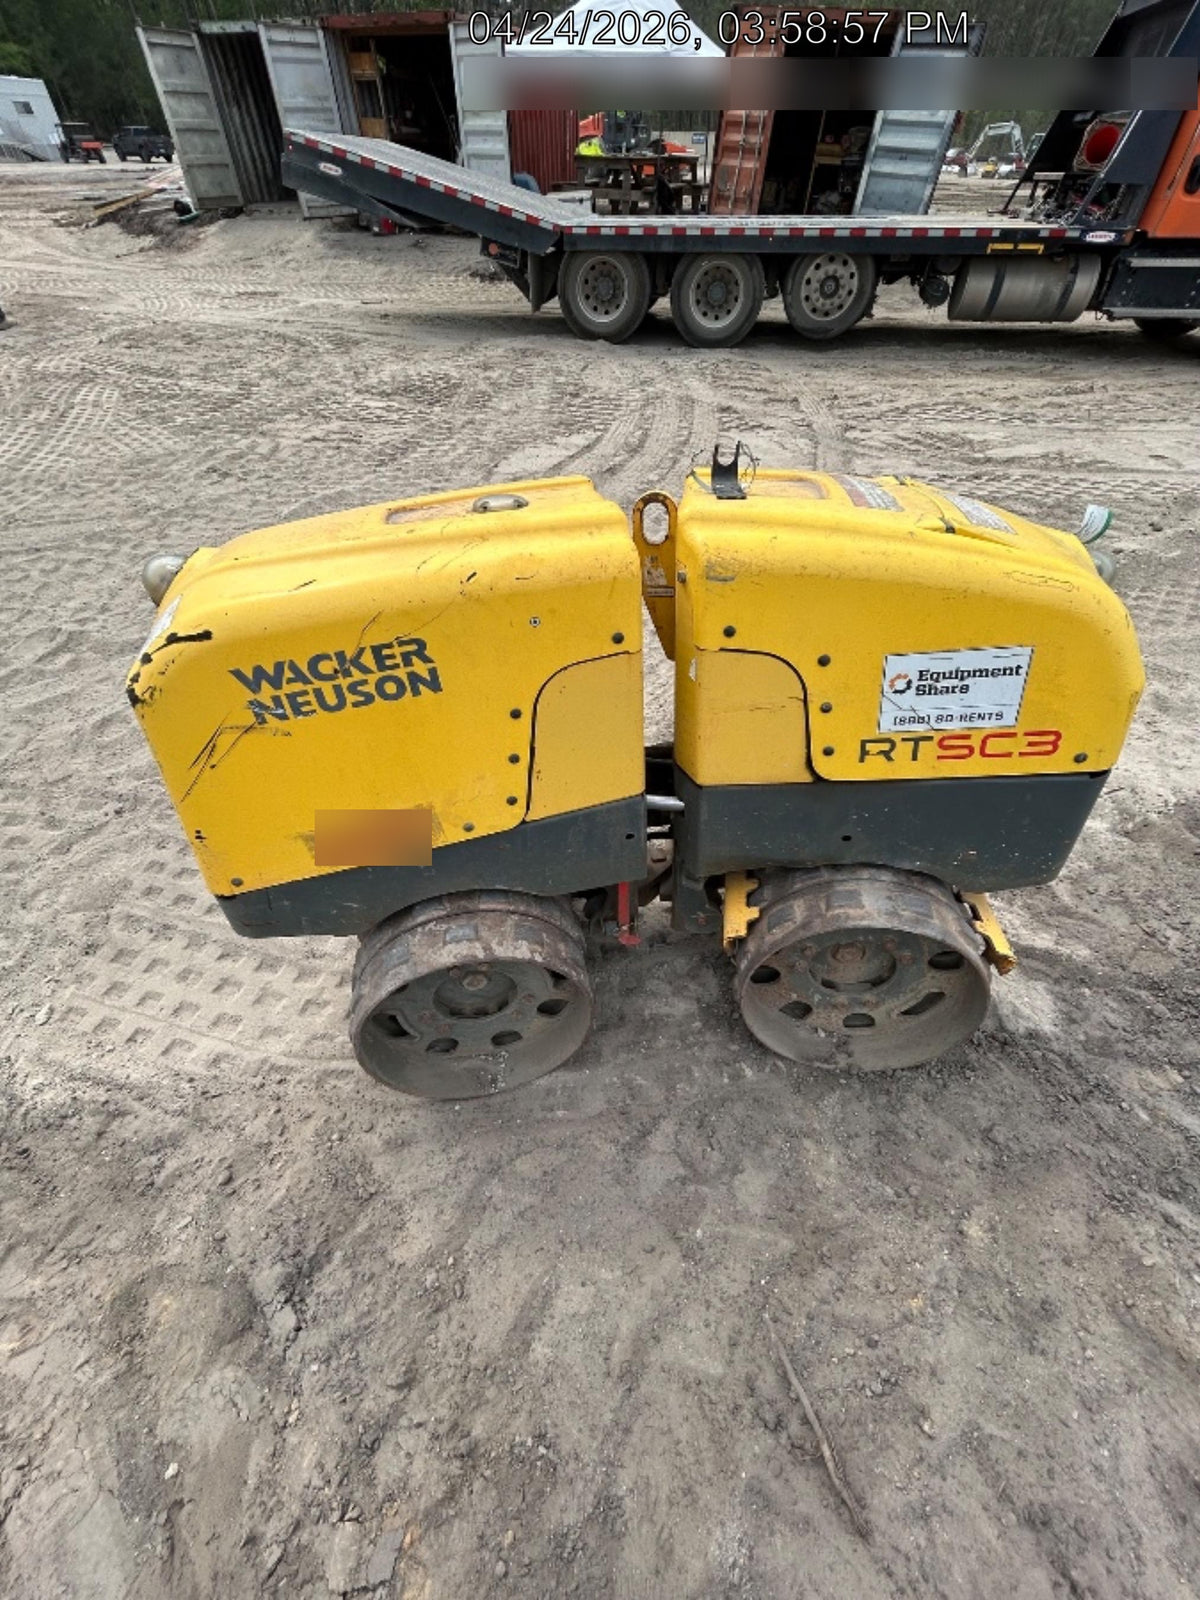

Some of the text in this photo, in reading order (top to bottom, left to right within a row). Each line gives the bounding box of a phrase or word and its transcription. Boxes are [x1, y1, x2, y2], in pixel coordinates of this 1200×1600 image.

[228, 637, 436, 695] WACKER
[917, 664, 1023, 683] Equipment
[247, 667, 443, 725] NEUSON
[915, 683, 970, 696] Share
[858, 730, 1063, 764] RTSC3
